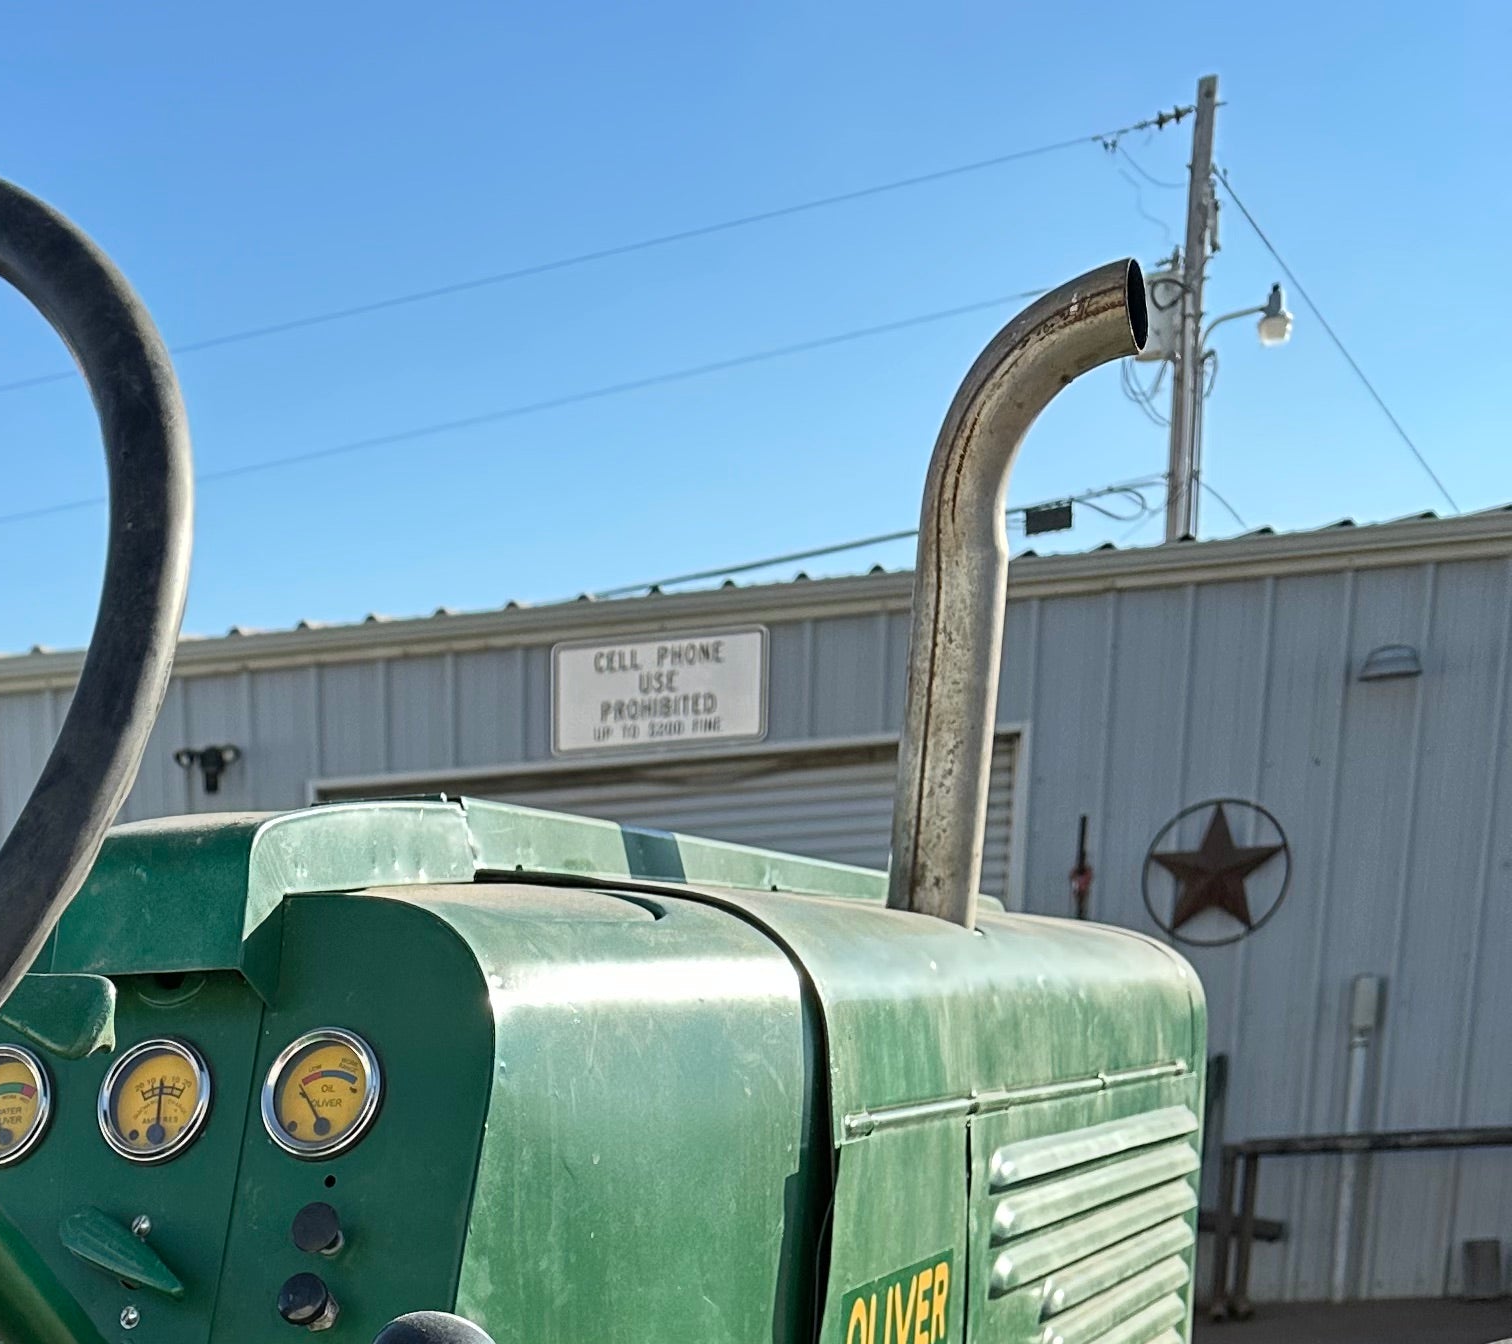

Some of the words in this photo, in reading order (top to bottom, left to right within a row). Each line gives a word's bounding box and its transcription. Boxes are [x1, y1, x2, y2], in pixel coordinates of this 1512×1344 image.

[593, 649, 642, 674] CELL
[656, 640, 725, 667] PHONE
[638, 670, 679, 695] USE
[600, 692, 718, 723] PROHIBITED
[593, 725, 614, 742] UP
[621, 722, 640, 740] TO
[320, 1084, 336, 1093] OIL
[311, 1098, 342, 1108] OLIVER
[142, 1116, 178, 1124] AMPRES
